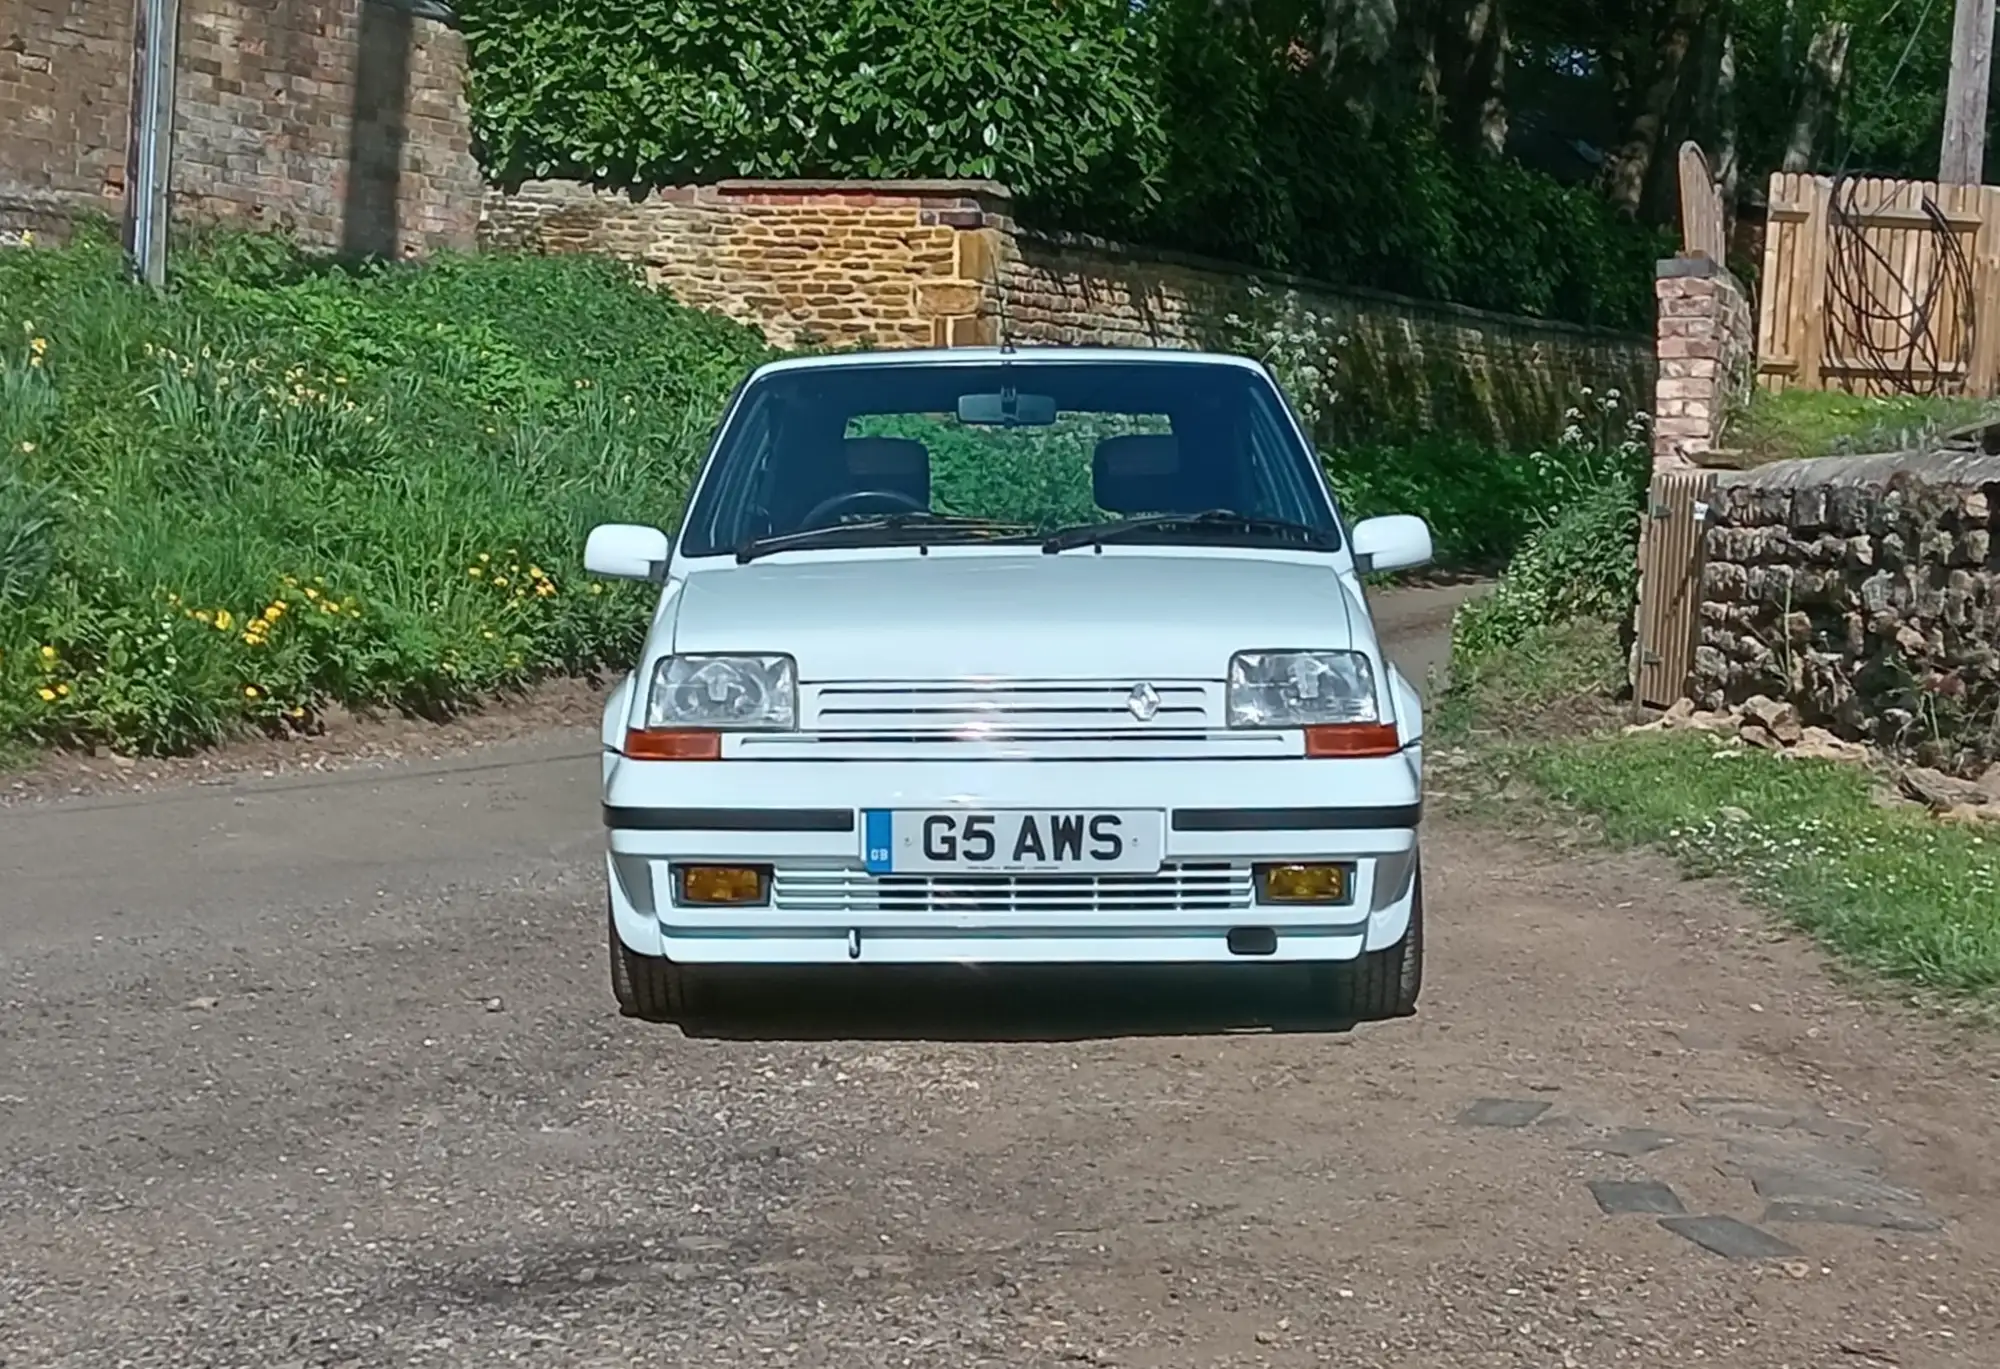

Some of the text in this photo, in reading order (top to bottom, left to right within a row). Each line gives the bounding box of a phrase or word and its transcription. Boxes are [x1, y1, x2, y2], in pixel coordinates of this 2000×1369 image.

[923, 815, 1123, 861] G5 AWS
[870, 848, 889, 861] GB
